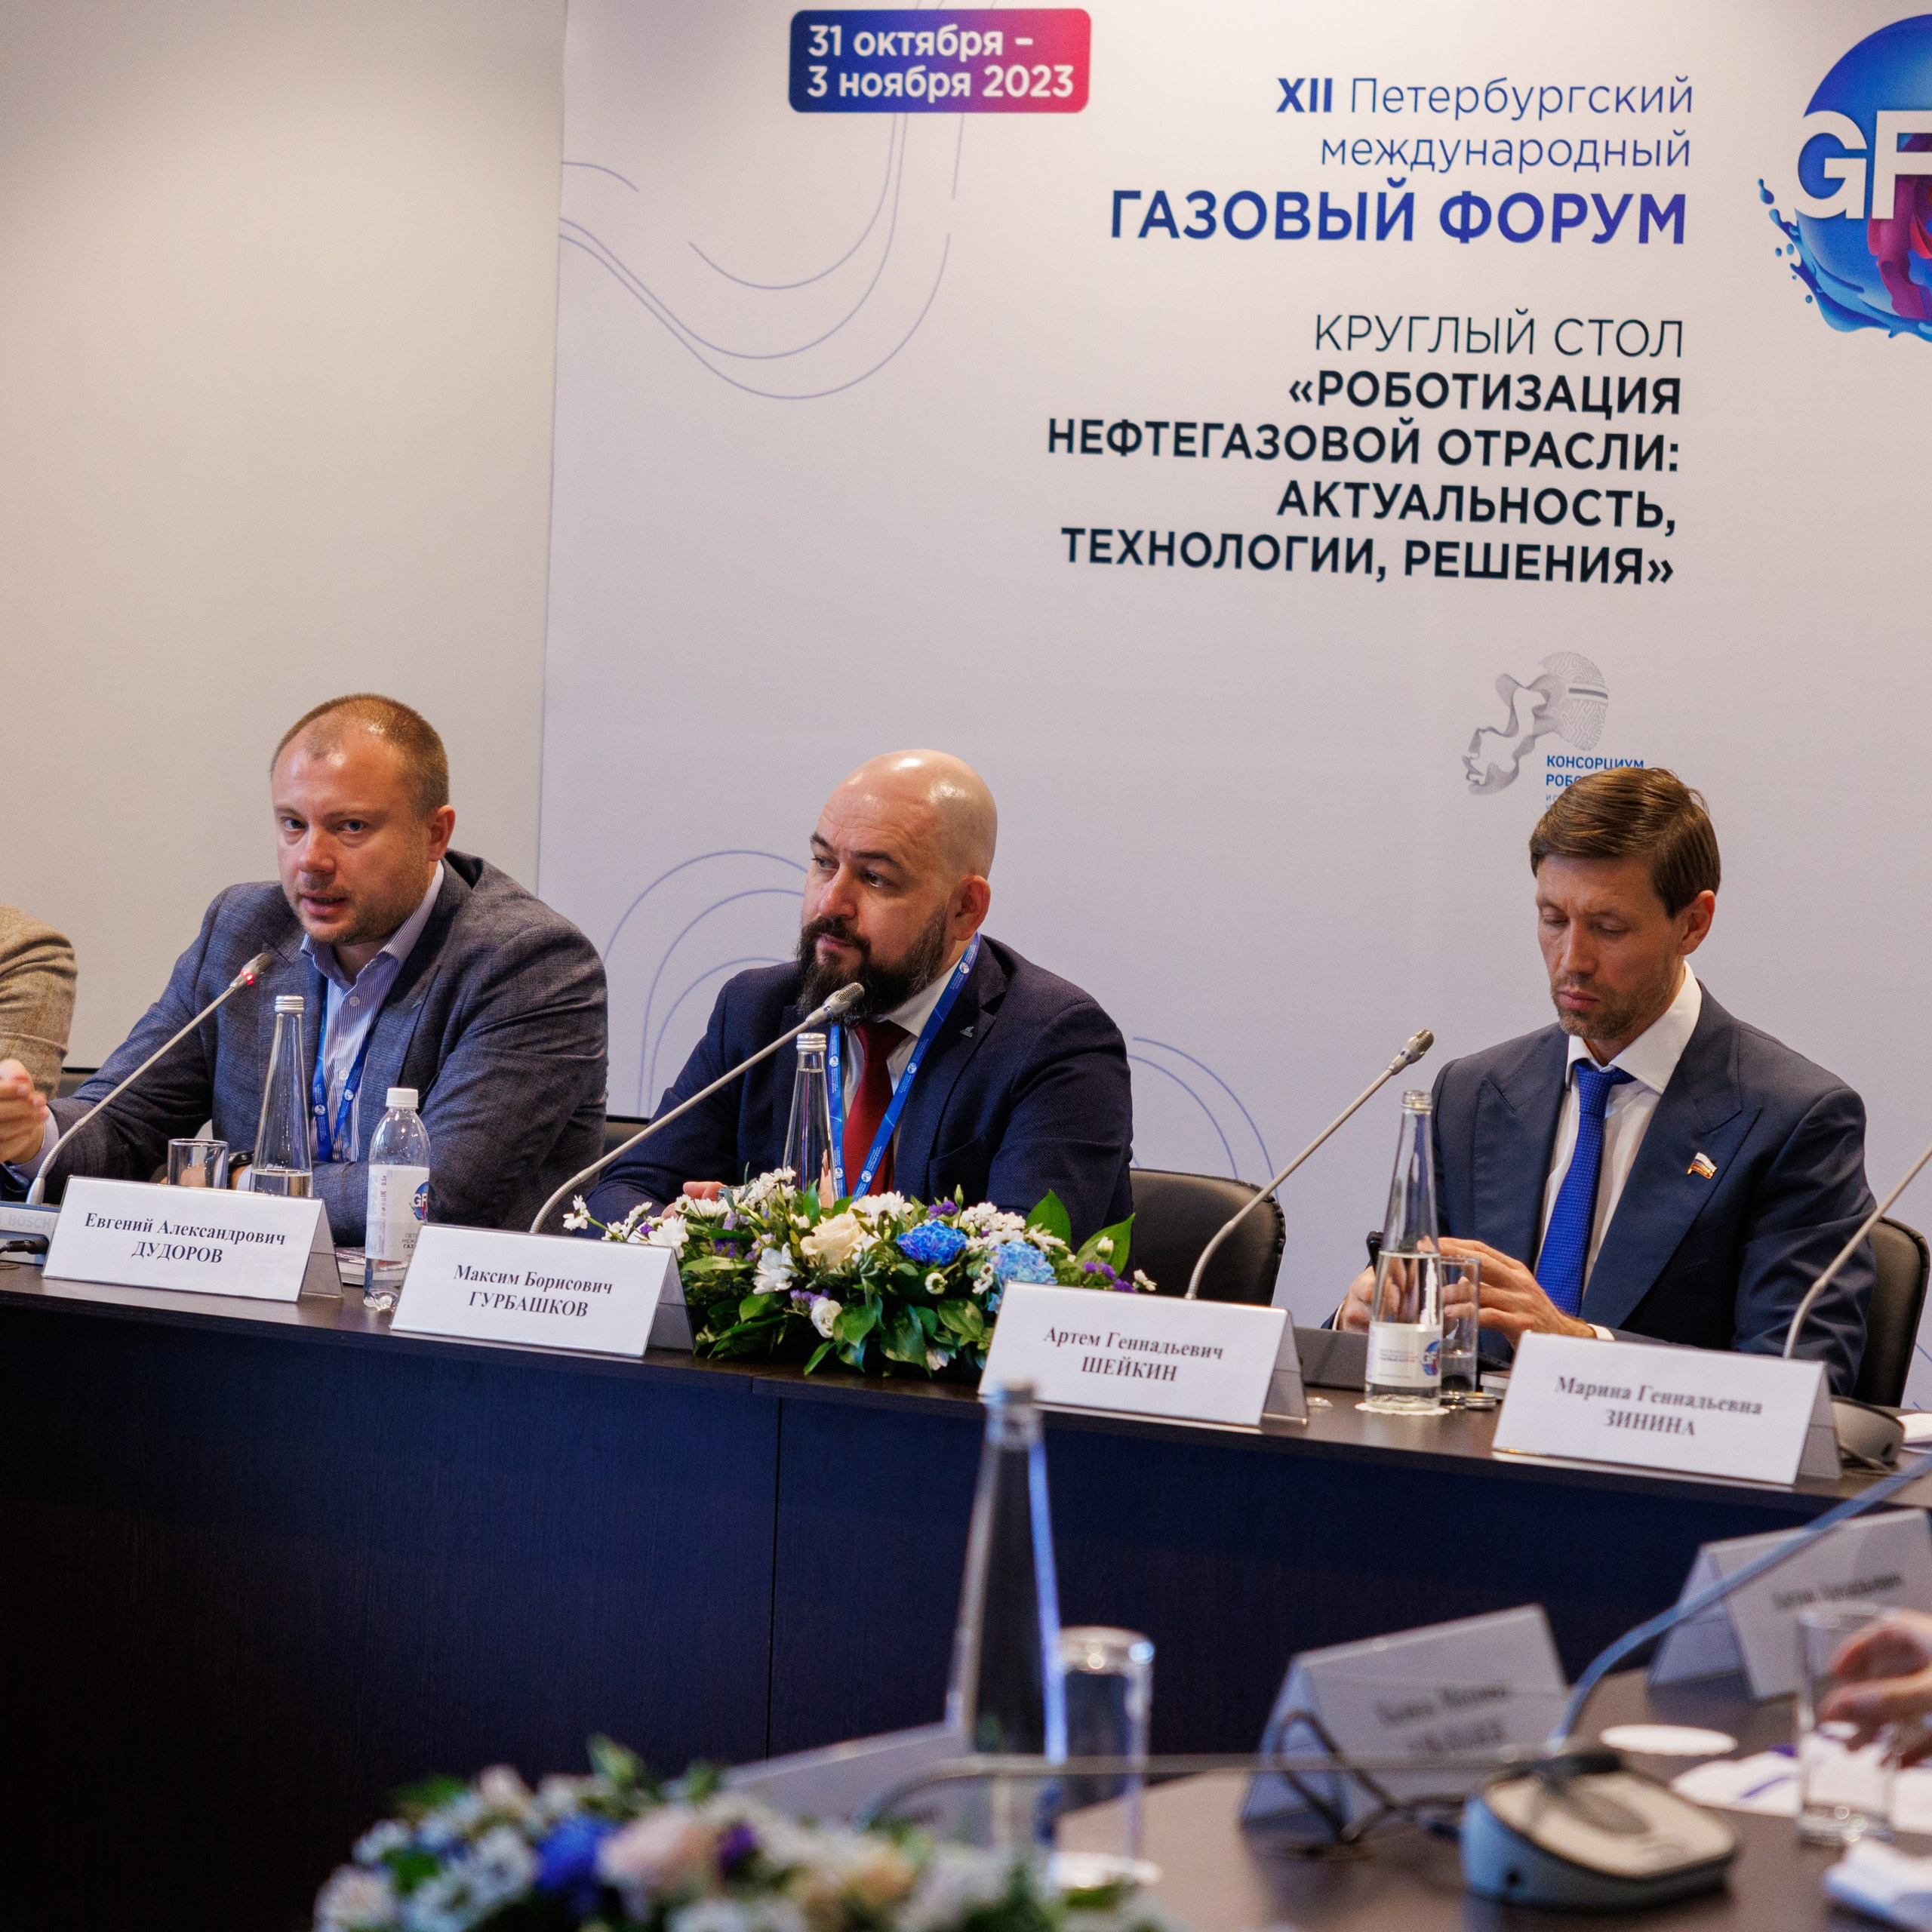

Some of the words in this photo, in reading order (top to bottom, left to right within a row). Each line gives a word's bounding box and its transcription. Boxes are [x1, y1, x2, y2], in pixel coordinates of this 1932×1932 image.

[808, 25, 841, 57] 31
[854, 23, 1004, 63] октября
[807, 65, 828, 97] 3
[839, 65, 972, 103] ноября
[982, 64, 1075, 97] 2023
[1275, 77, 1333, 113] XII
[1350, 75, 1694, 122] Петербургский
[1321, 129, 1691, 174] международный
[1110, 177, 1416, 242] ГАЗОВЫЙ
[1438, 190, 1687, 245] ФОРУМ
[1315, 308, 1536, 355] КРУГЛЫЙ
[1552, 318, 1684, 358] СТОЛ
[1287, 370, 1681, 420] «РОБОТИЗАЦИЯ
[1048, 417, 1420, 465] НЕФТЕГАЗОВОЙ
[1437, 428, 1679, 472] ОТРАСЛИ:
[1275, 479, 1677, 537] АКТУАЛЬНОСТЬ,
[1060, 526, 1387, 583] ТЕХНОЛОГИИ,
[1404, 540, 1675, 585] РЕШЕНИЯ»
[1546, 755, 1644, 771] КОНСОРЦИУМ
[84, 1211, 154, 1233] Евгений
[156, 1220, 286, 1246] Александрович
[131, 1241, 224, 1264] ДУДОРОВ
[454, 1264, 520, 1286] Максим
[525, 1271, 614, 1295] Борисович
[468, 1291, 589, 1318] ГУРБАШКОВ
[1043, 1326, 1101, 1349] Артем
[1106, 1331, 1224, 1361] Геннадьевич
[1080, 1355, 1178, 1383] ШЕЙКИН
[1555, 1375, 1632, 1401] Марина
[1635, 1384, 1764, 1416] Геннадьевна
[1605, 1410, 1697, 1437] ЗИНИНА
